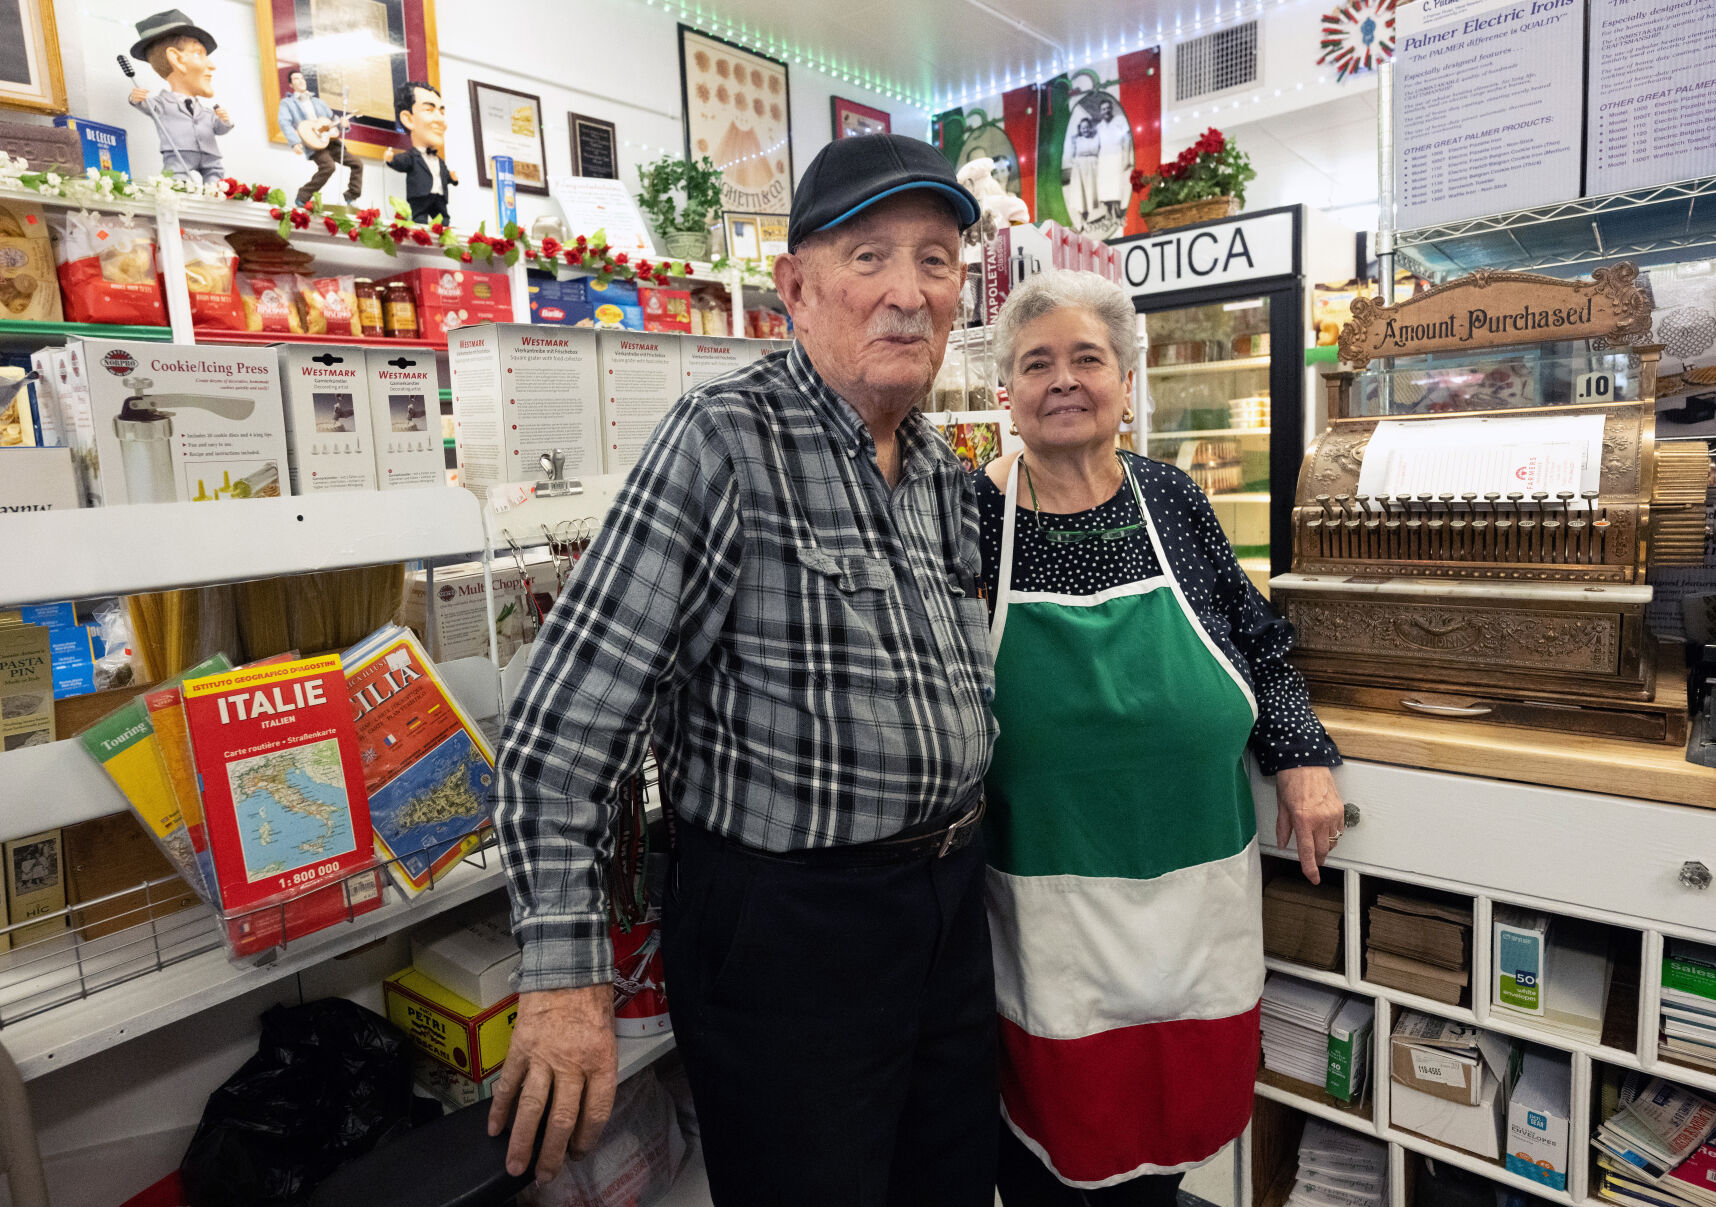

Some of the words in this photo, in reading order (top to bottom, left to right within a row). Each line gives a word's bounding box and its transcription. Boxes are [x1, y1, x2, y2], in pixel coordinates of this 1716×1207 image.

[1404, 29, 1458, 52] Palmer
[1463, 8, 1525, 35] Electric
[1530, 0, 1575, 16] Irons
[1601, 11, 1647, 28] Especially
[1429, 42, 1465, 58] PALMER
[1467, 31, 1508, 47] difference
[1404, 65, 1441, 82] Especially
[1443, 55, 1477, 71] designed
[1600, 98, 1634, 112] OTHER
[1636, 88, 1674, 104] GREAT
[1404, 144, 1432, 157] OTHER
[1433, 136, 1463, 150] GREAT
[1464, 127, 1500, 142] PALMER
[1501, 115, 1555, 133] PRODUCTS:
[1124, 226, 1255, 289] OTICA
[986, 243, 999, 324] NAPOLETAN
[1374, 317, 1457, 350] Amount
[1459, 297, 1593, 343] Purchased
[151, 359, 233, 377] Cookie/Icing
[236, 362, 270, 375] Press
[1579, 374, 1609, 398] .10
[458, 582, 485, 597] Mult
[491, 576, 536, 592] Choppr
[0, 656, 44, 671] PASTA
[10, 667, 36, 679] PIN
[192, 678, 233, 692] ISTITUTO
[234, 668, 289, 684] GEOGRAFICO
[217, 678, 328, 726] ITALIE
[260, 715, 296, 729] ITALIEN
[100, 721, 147, 751] Touring
[223, 747, 248, 759] Carte
[248, 740, 281, 753] routière
[293, 869, 316, 884] 800
[317, 861, 340, 876] 000
[1516, 973, 1535, 986] 50
[1671, 962, 1716, 979] Sales
[1503, 990, 1537, 1002] envelopes
[1517, 988, 1537, 997] white
[407, 1005, 447, 1034] PETRI
[1331, 1062, 1341, 1071] 40
